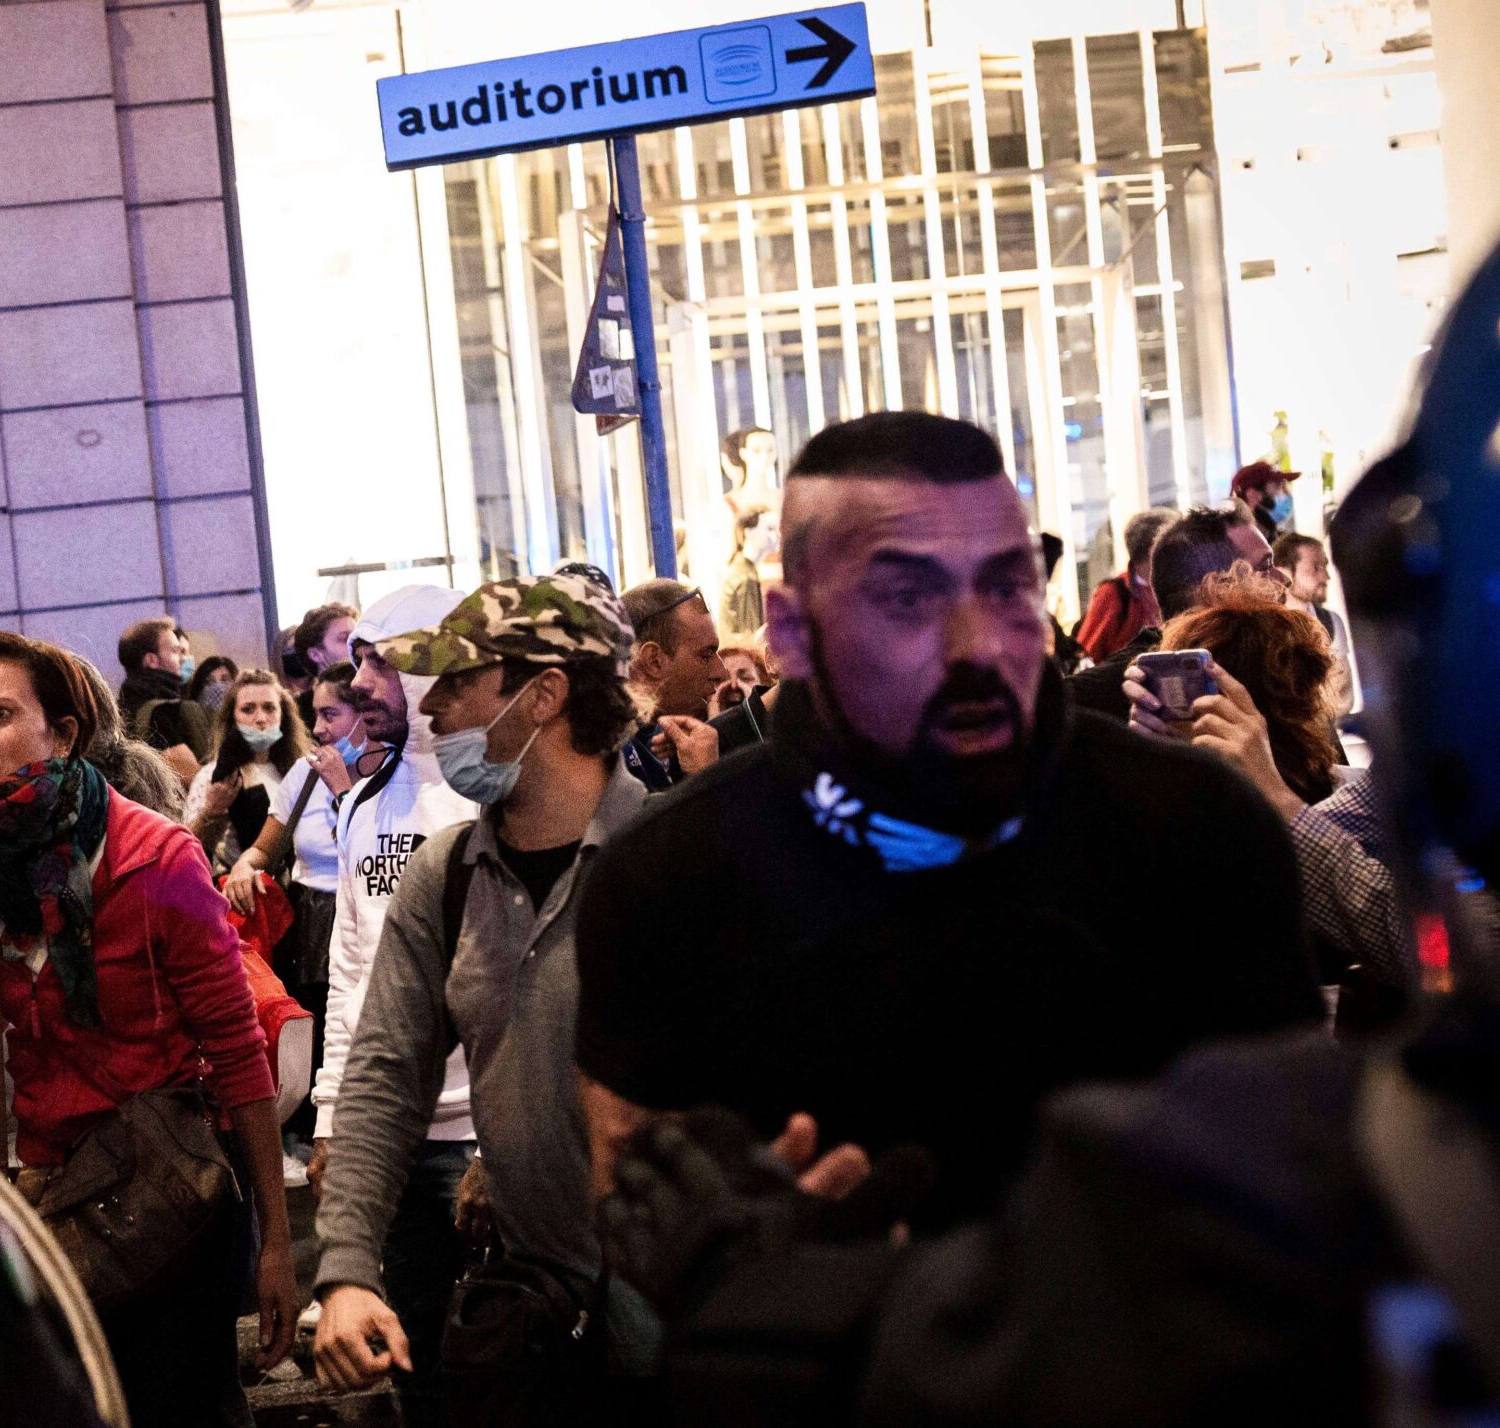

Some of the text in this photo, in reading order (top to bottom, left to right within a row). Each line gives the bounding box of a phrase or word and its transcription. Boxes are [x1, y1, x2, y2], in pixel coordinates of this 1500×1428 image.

[397, 65, 688, 136] auditorium
[377, 833, 412, 854] THE
[355, 854, 409, 878] NORTH
[366, 875, 400, 897] FAC
